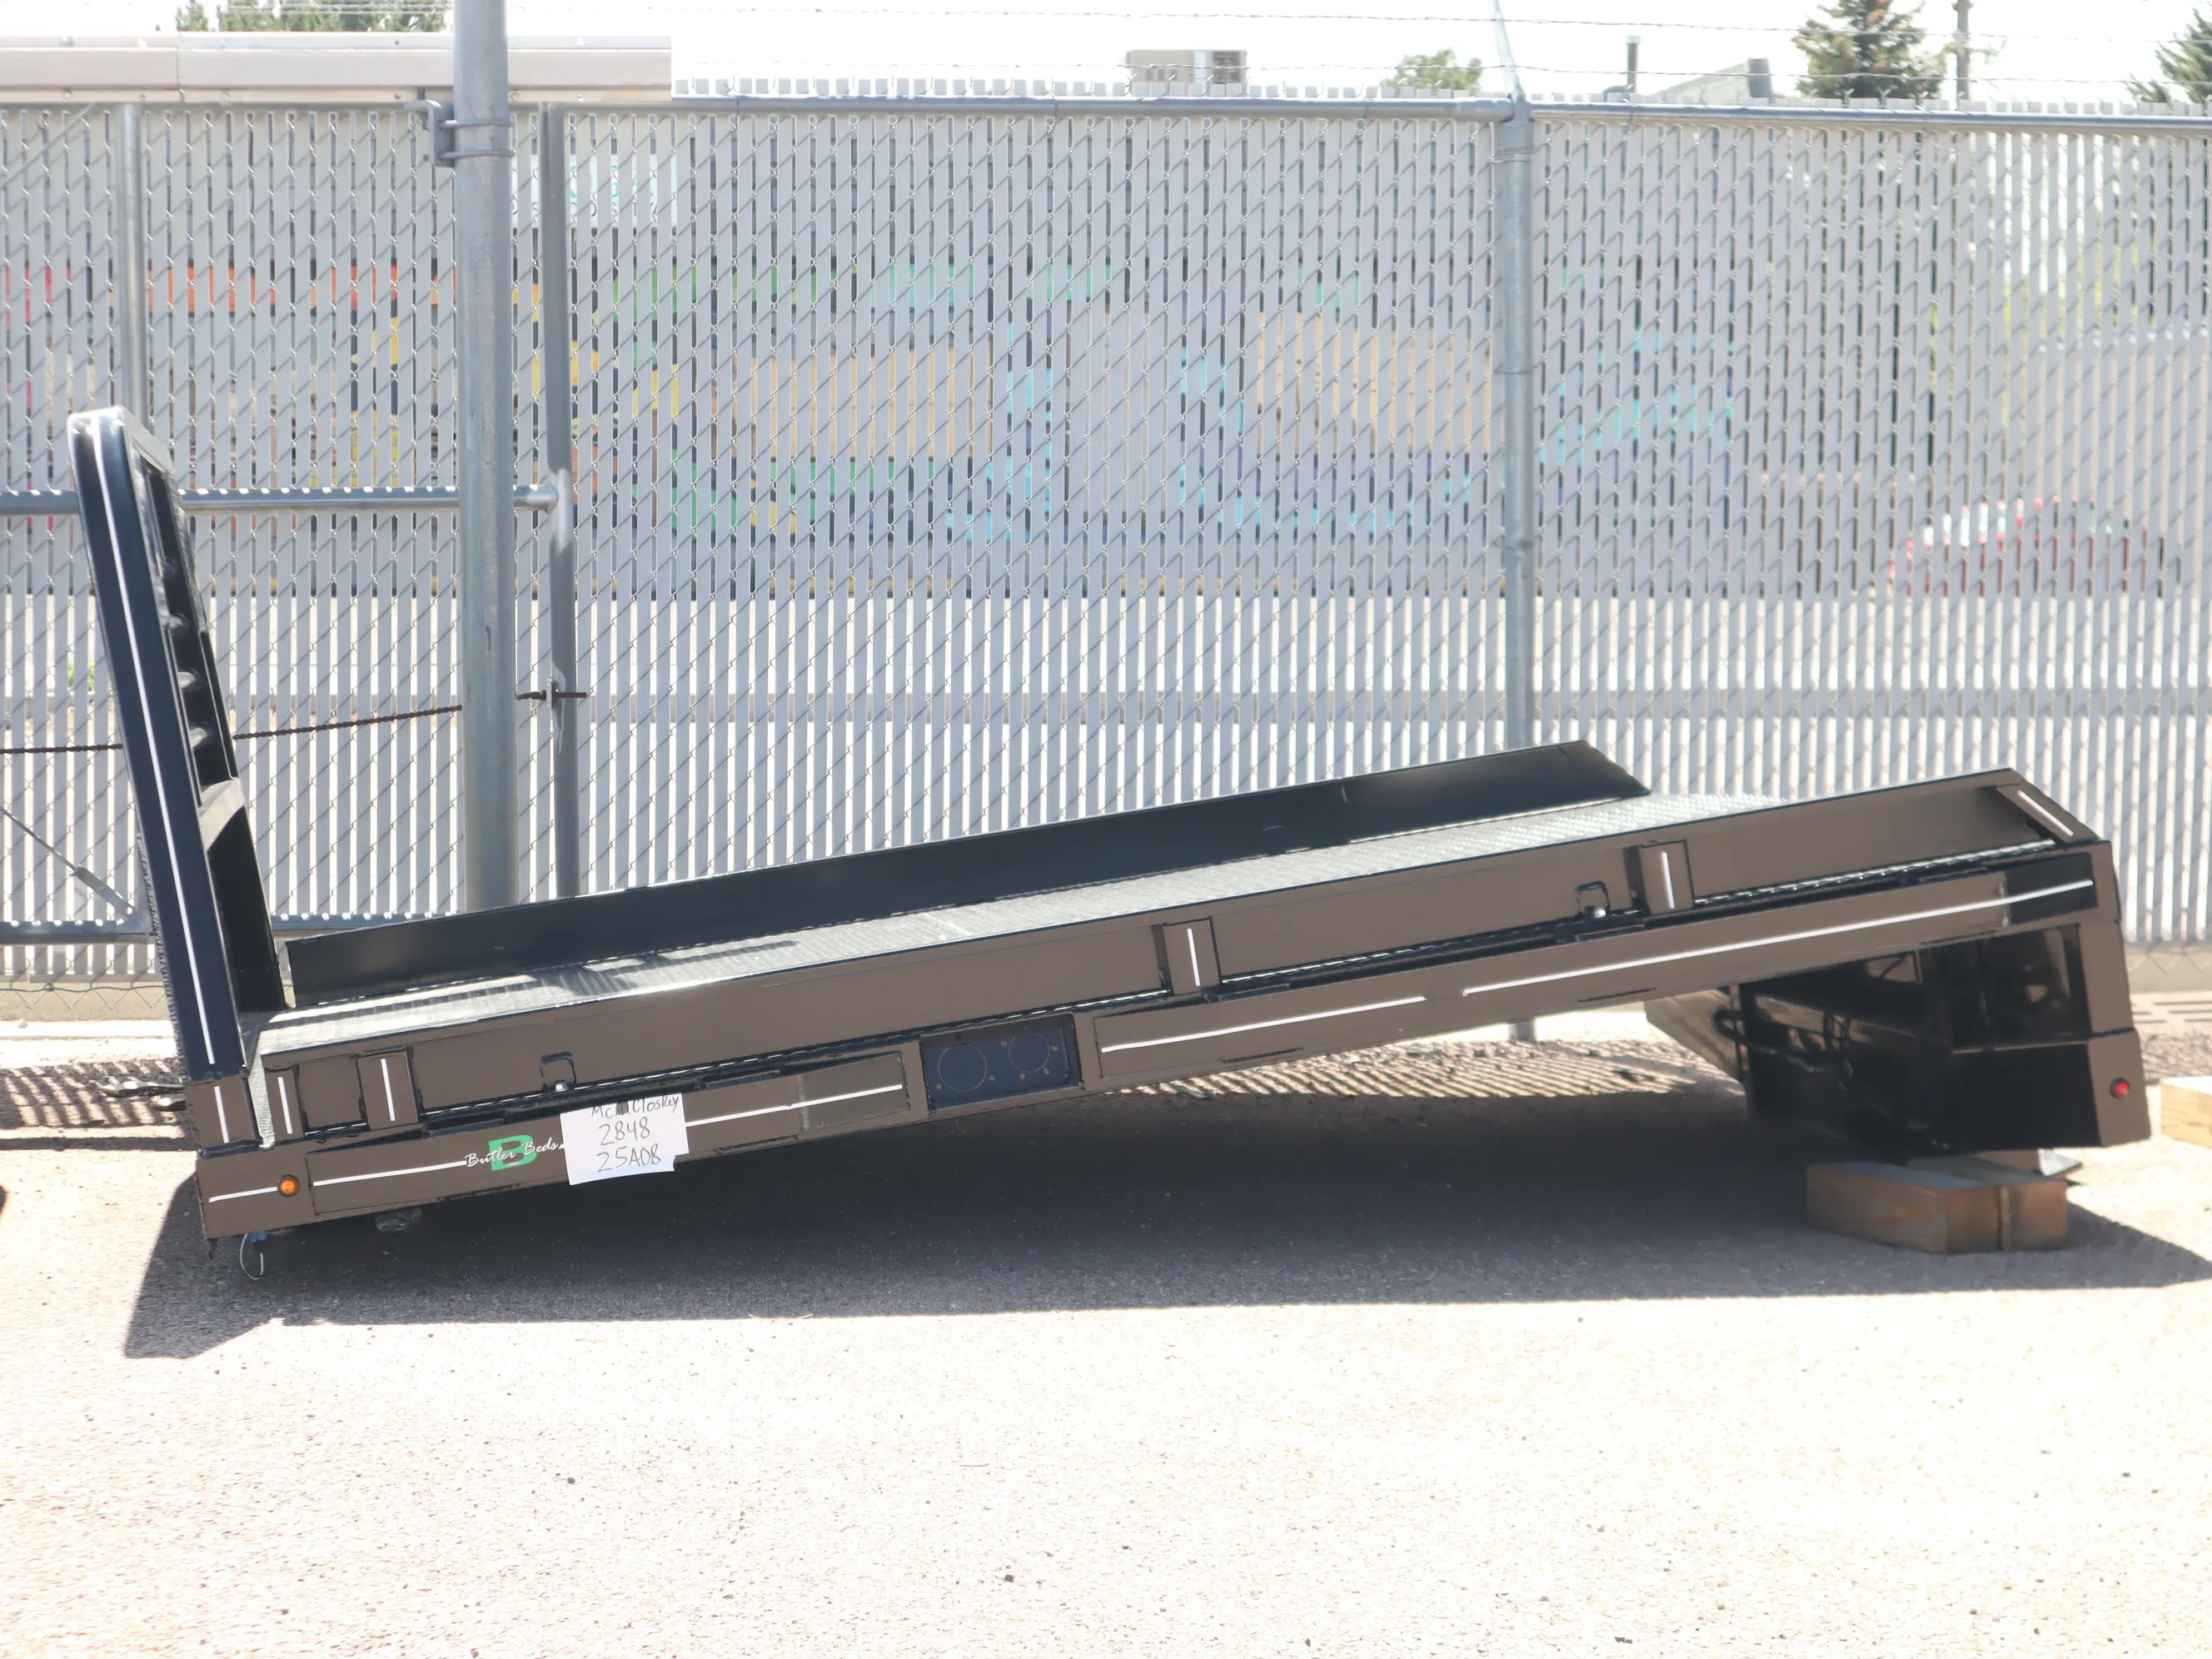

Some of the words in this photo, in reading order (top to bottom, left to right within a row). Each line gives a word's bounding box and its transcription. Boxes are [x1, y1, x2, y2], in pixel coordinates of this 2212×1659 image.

[599, 1116, 650, 1146] 2848
[465, 1147, 516, 1167] Butler
[521, 1137, 559, 1155] Beds
[596, 1143, 660, 1173] 25A08
